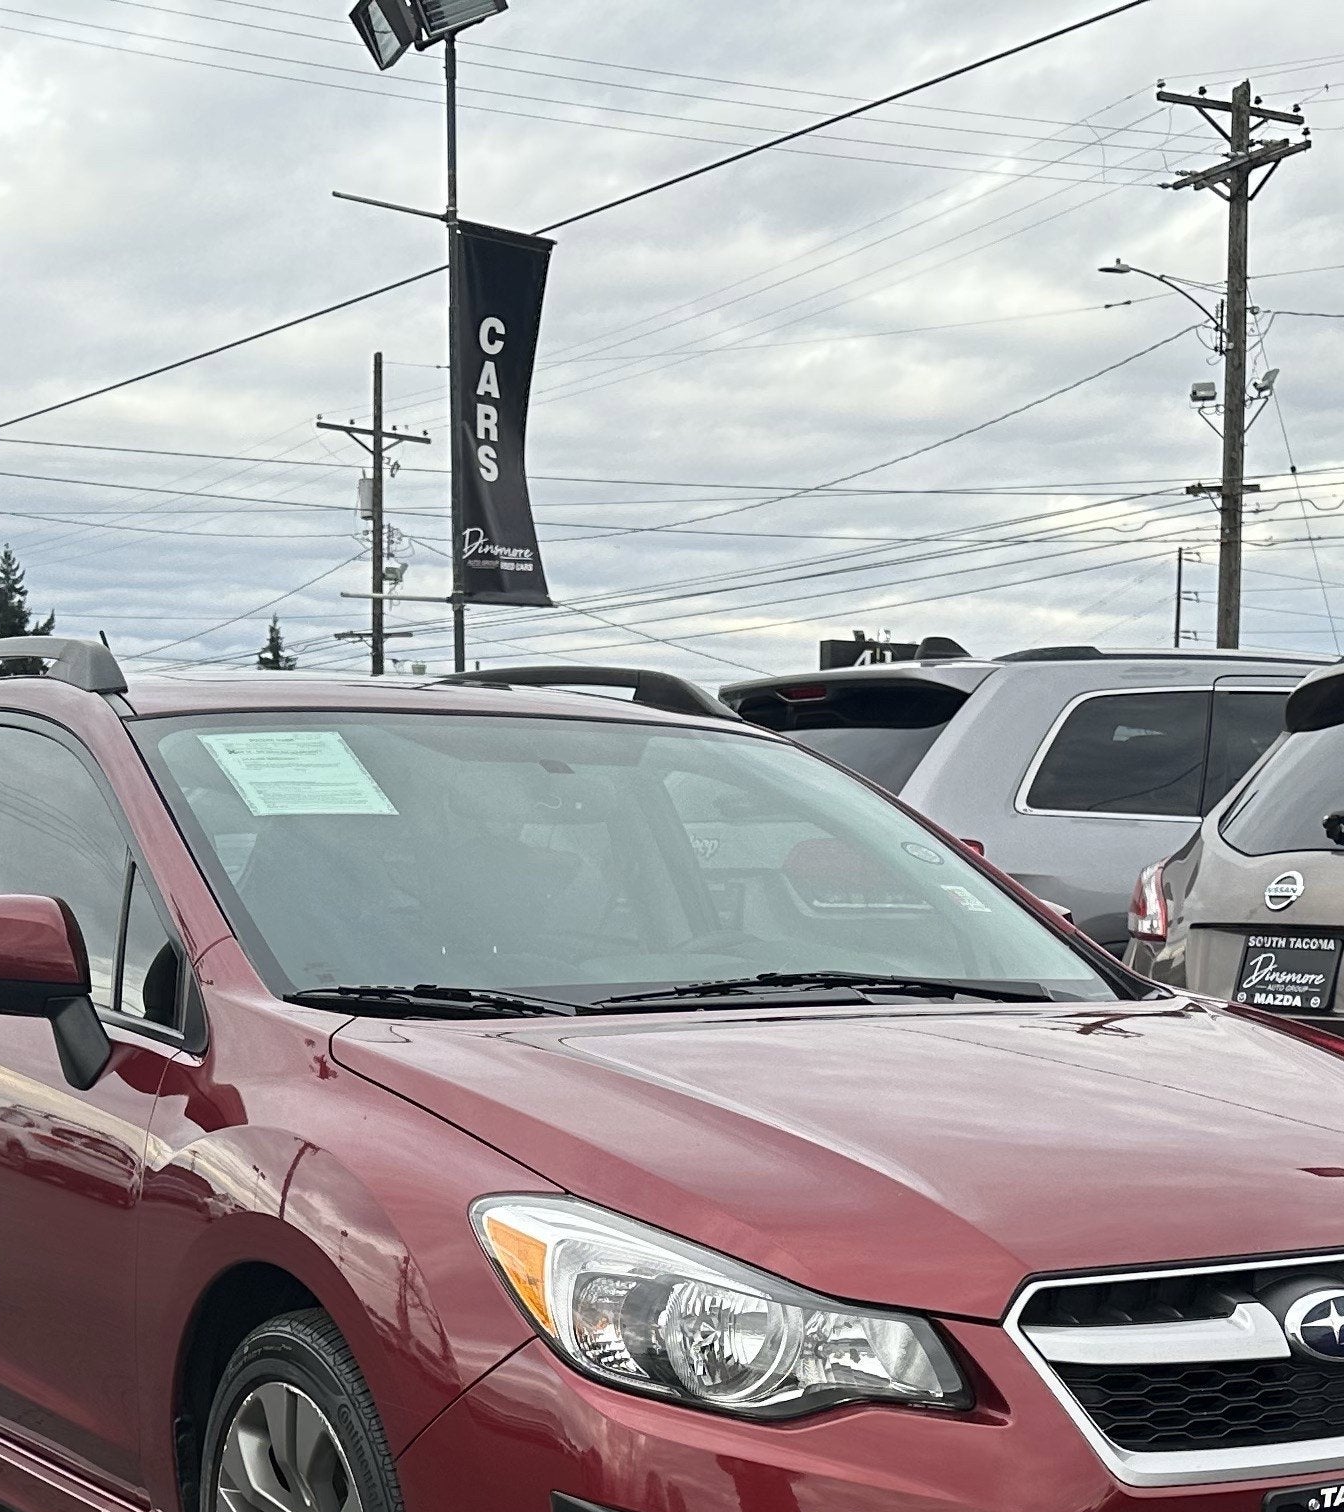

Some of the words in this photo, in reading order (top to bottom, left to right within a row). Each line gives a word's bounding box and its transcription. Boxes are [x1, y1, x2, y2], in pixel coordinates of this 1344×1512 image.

[476, 316, 506, 483] CARS
[462, 527, 534, 559] Dinsmore
[1248, 936, 1287, 948] SOUTH
[1289, 938, 1335, 951] TACOMA
[1242, 953, 1326, 988] Dinsmore
[1253, 993, 1302, 1007] MAZDA
